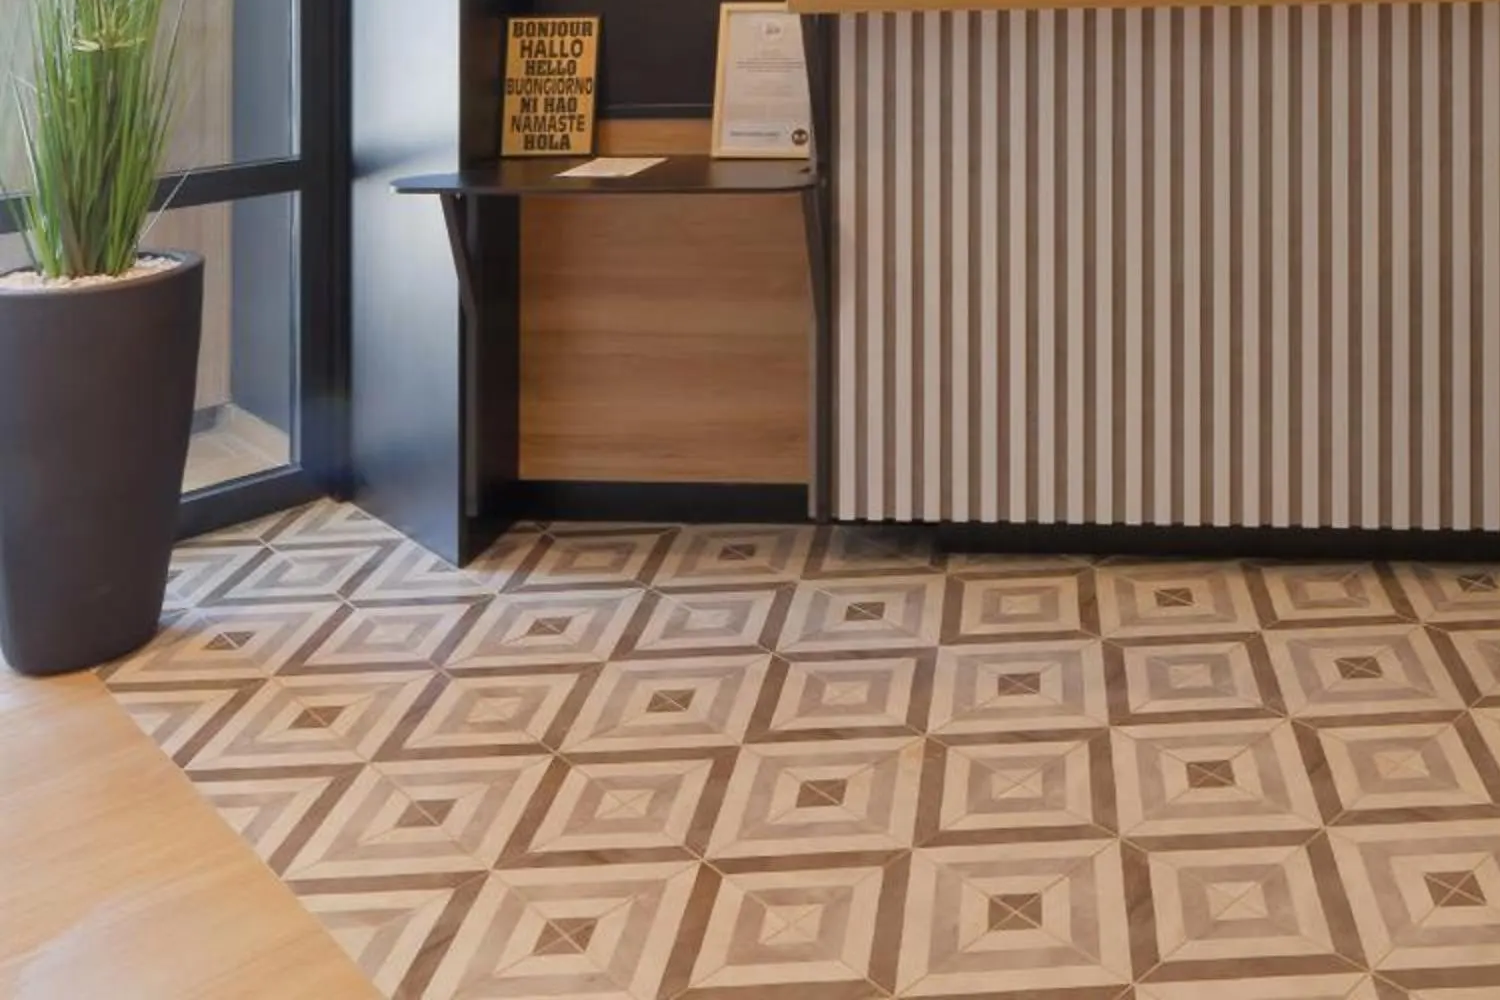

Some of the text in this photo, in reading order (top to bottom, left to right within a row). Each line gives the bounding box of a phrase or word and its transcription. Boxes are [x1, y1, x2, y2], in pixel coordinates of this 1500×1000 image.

[513, 21, 593, 37] BONJOUR
[520, 39, 584, 58] HALLO
[524, 59, 577, 76] HELLO
[507, 77, 593, 96] BUONGIORNO
[520, 97, 577, 113] NI HAO
[511, 114, 585, 133] NAMASTE
[523, 134, 571, 151] HOLA
